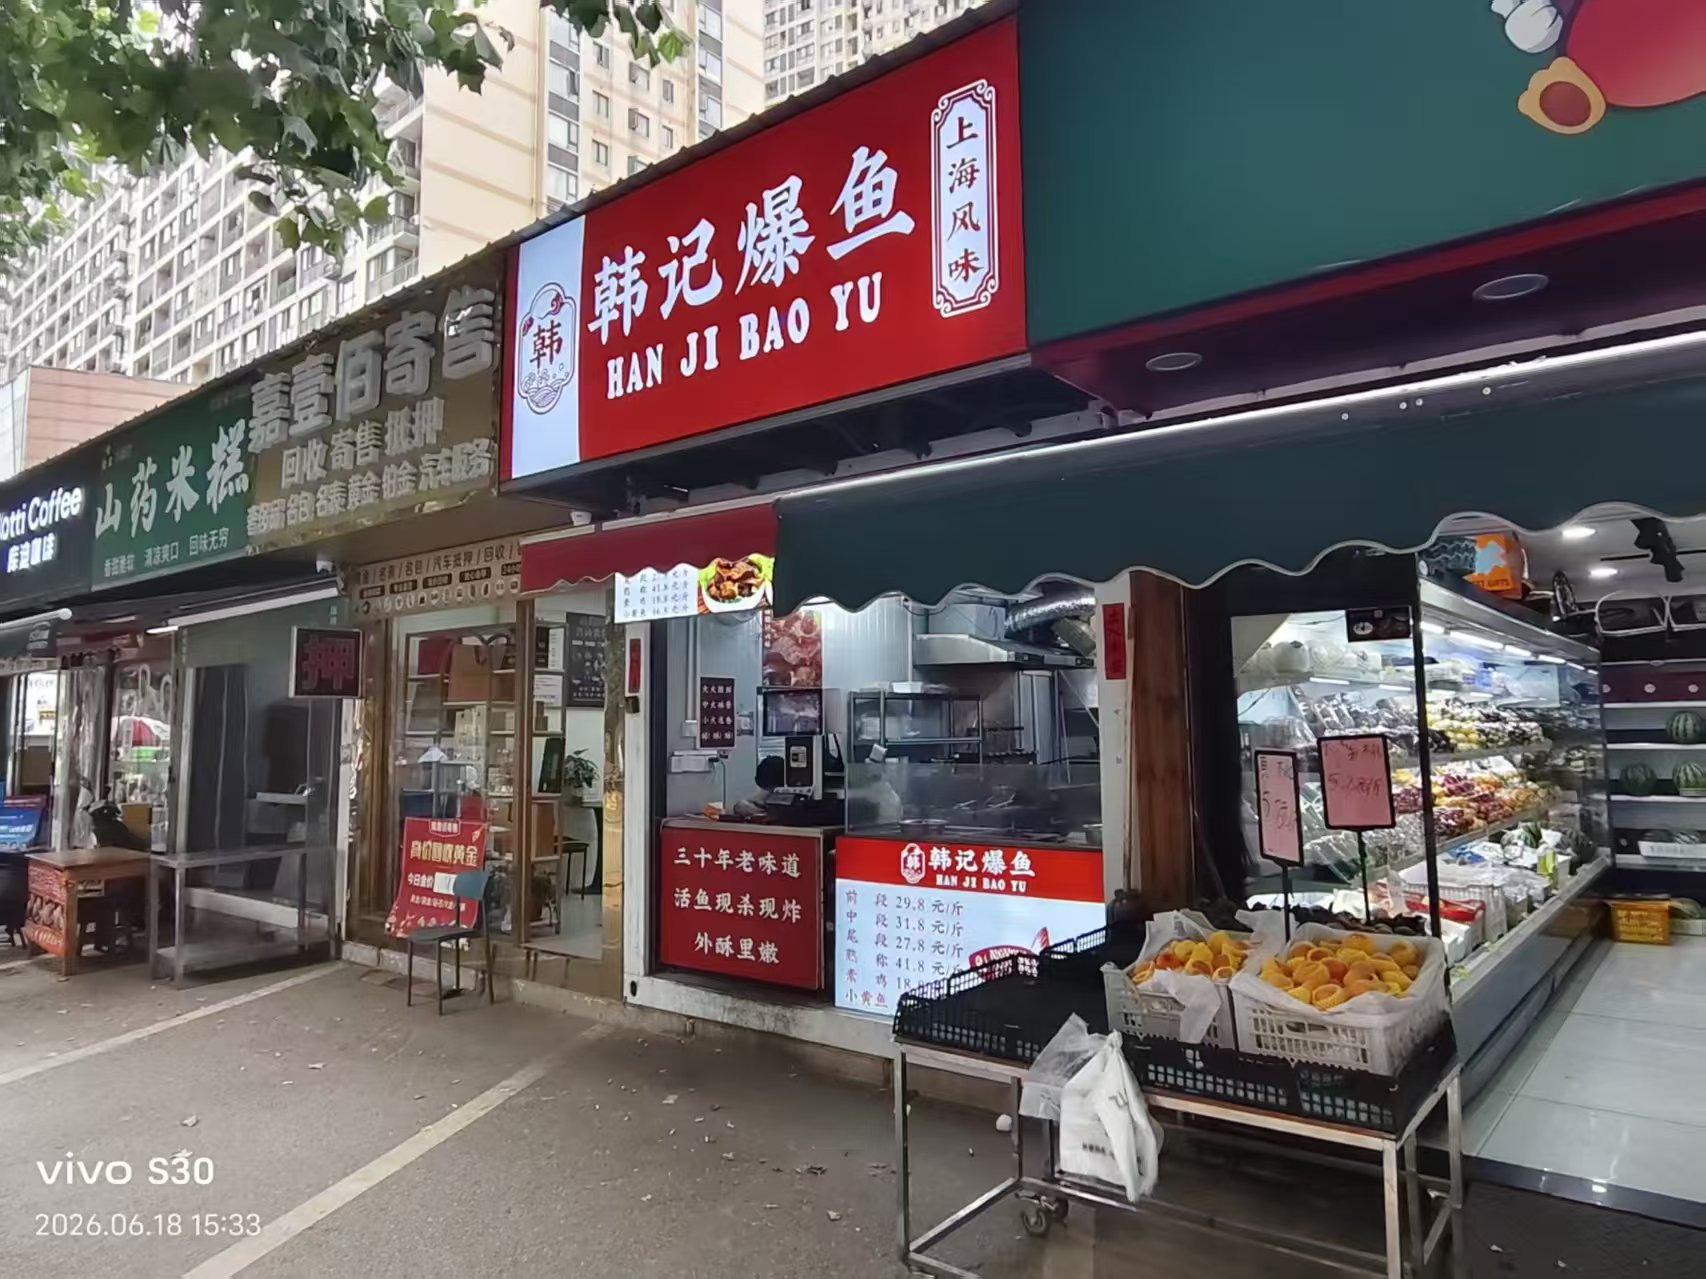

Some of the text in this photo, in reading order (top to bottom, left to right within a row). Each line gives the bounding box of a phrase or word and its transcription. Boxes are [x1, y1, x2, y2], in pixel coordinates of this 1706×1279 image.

[946, 117, 984, 282] 上海风味
[587, 145, 915, 344] 韩记爆鱼
[529, 320, 563, 372] 韩
[607, 272, 882, 399] HAN JI BAO YU
[281, 396, 445, 489] 回收 寄售 抵押
[95, 419, 249, 538] 山药米糕
[28, 487, 82, 531] Coffee
[189, 527, 229, 556] 回味无穷
[411, 840, 478, 867] 高价回收黄金
[674, 847, 801, 878] 三十年老味道
[928, 846, 1036, 877] 韩记爆鱼
[936, 874, 1027, 893] HAN JI BAO YU
[674, 887, 802, 923] 活鱼现杀现炸
[895, 895, 925, 912] 29.8
[931, 899, 964, 917] 元/斤
[896, 915, 925, 931] 31.8
[931, 920, 964, 938] 元/斤
[694, 931, 780, 964] 外酥里嫩
[895, 935, 925, 952] 27.8
[931, 940, 964, 958] 元/斤
[895, 957, 925, 973] 41.8
[845, 988, 888, 1009] 小黄鱼
